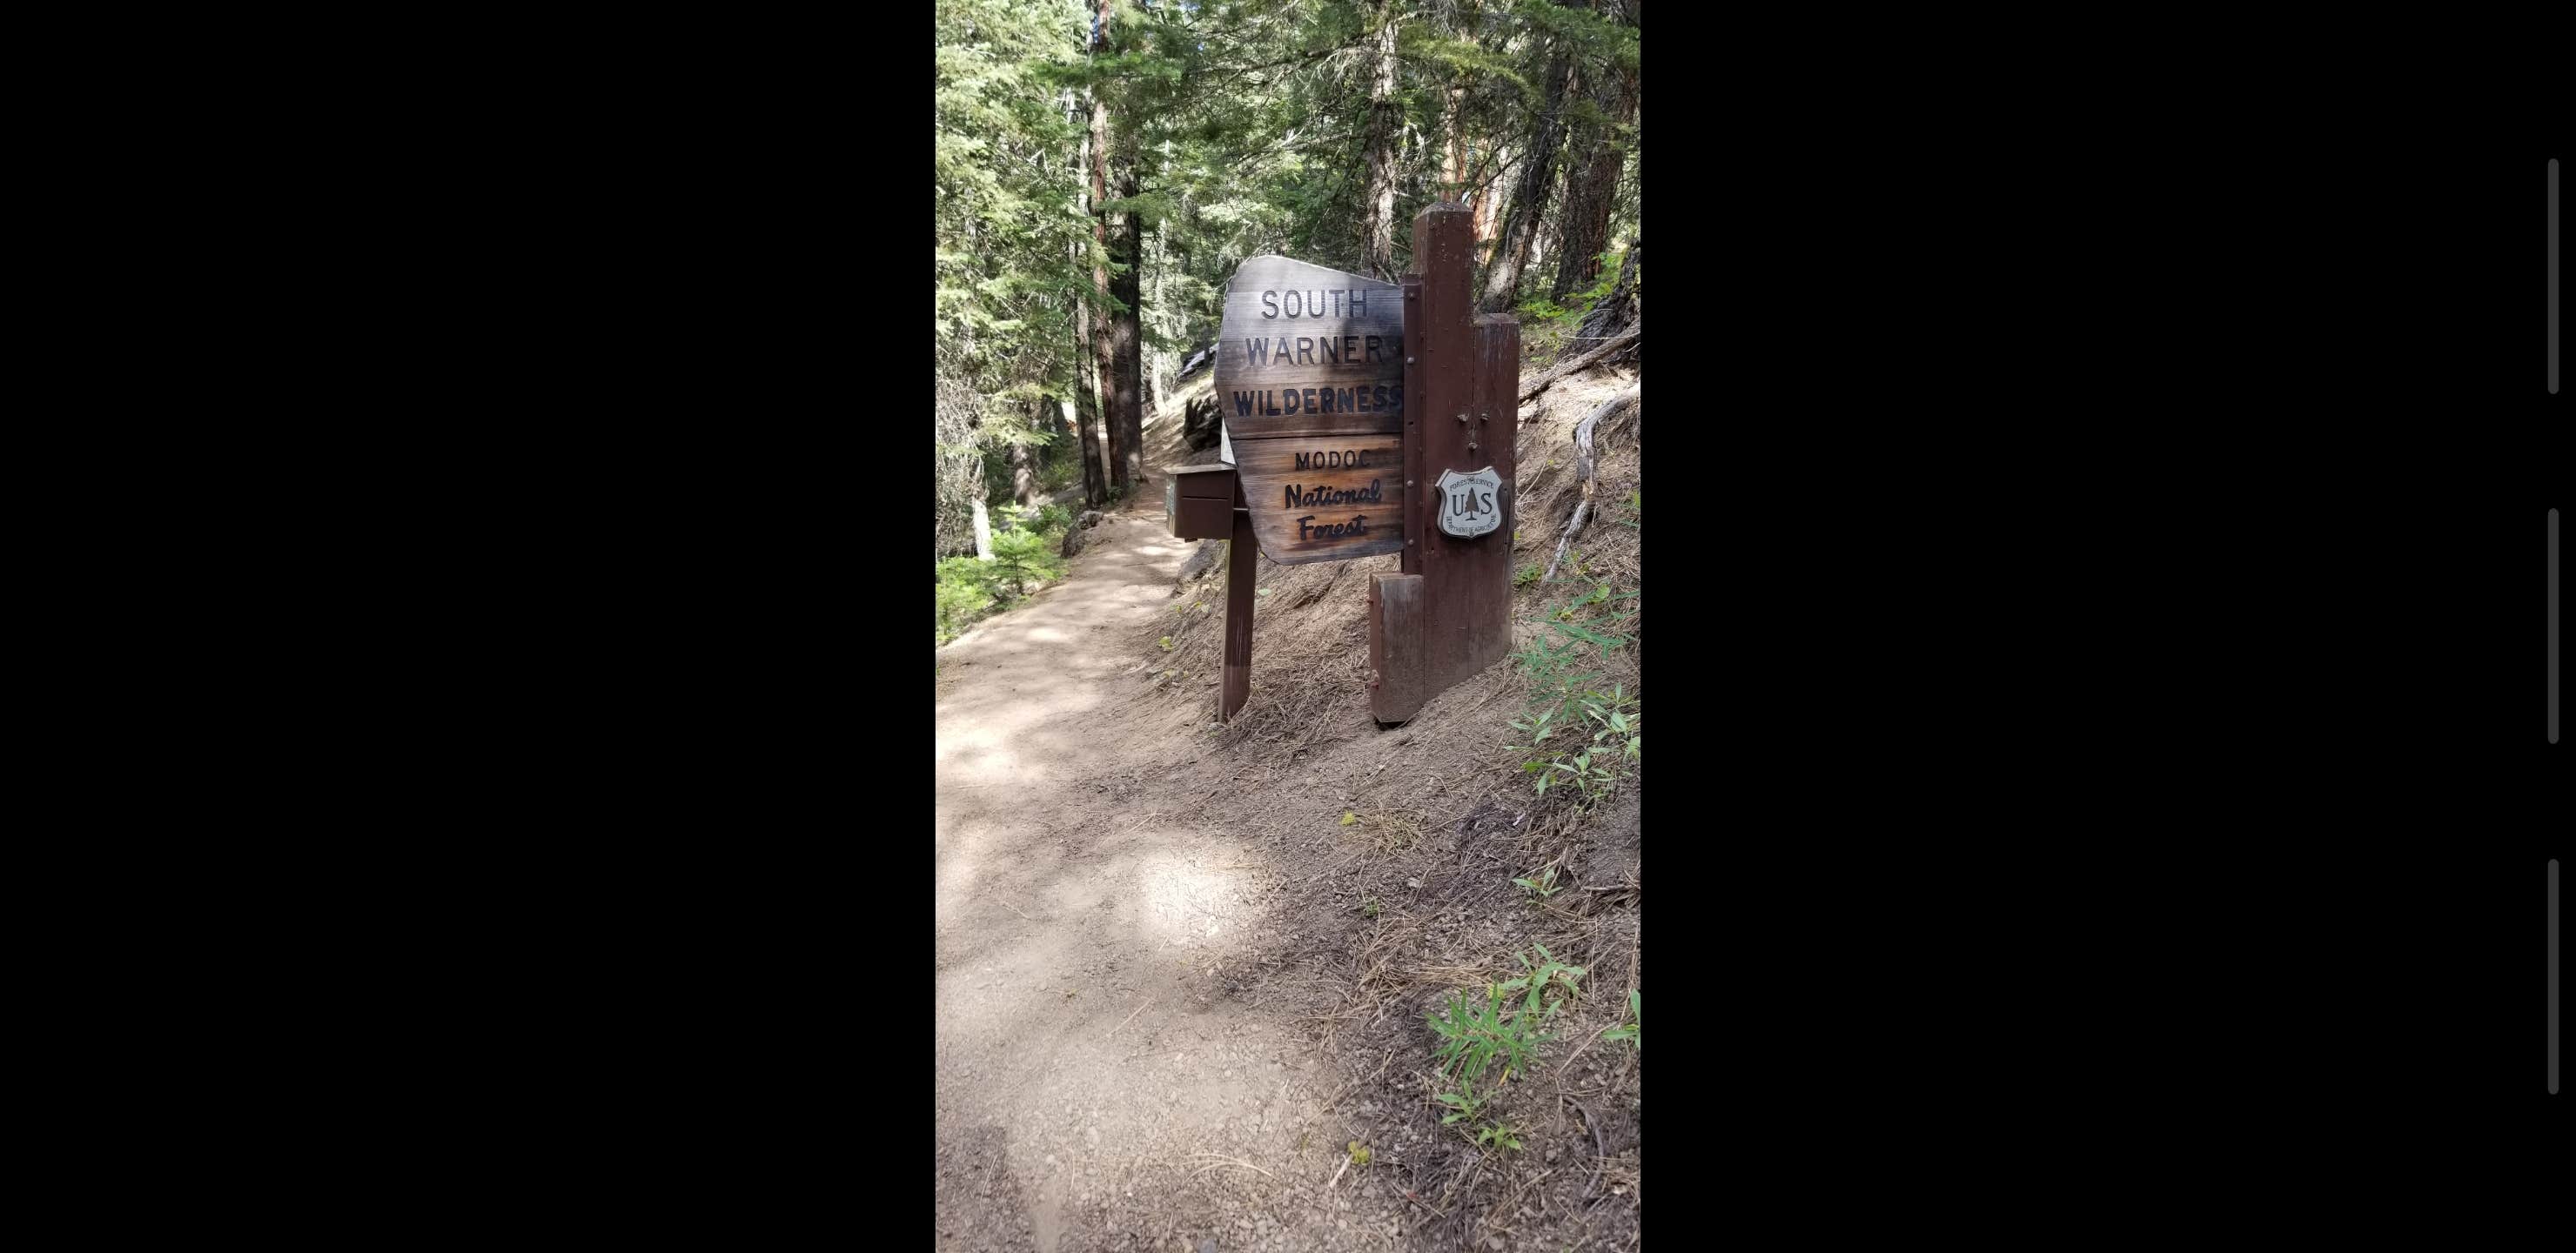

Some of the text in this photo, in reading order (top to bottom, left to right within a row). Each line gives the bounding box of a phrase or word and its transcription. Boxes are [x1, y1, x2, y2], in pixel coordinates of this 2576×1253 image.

[1261, 289, 1367, 319] SOUTH
[1245, 335, 1384, 366] WARNER
[1233, 385, 1403, 417] WILDERNESS
[1295, 449, 1372, 471] MODOC
[1285, 479, 1382, 508] National
[1297, 514, 1368, 540] Forest
